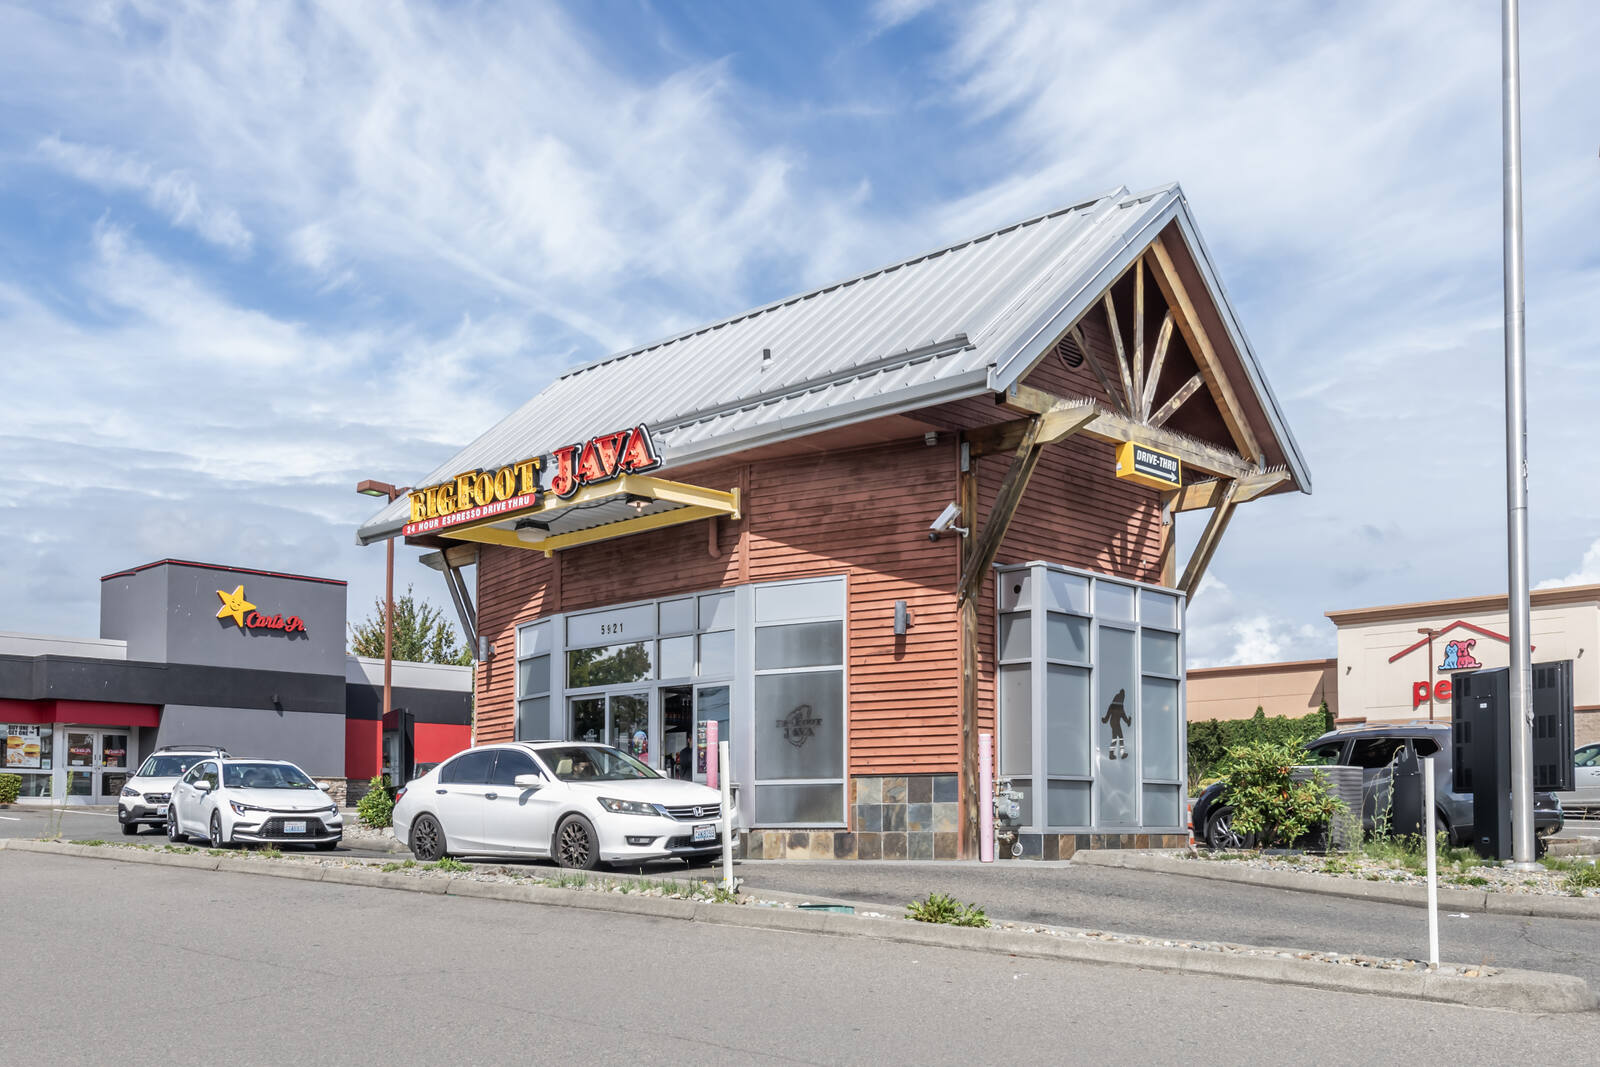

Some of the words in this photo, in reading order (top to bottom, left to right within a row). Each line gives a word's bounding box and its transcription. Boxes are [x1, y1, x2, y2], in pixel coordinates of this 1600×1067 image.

[408, 457, 541, 524] BIGFOOT
[552, 424, 660, 498] JAVA
[1136, 449, 1177, 472] DRIVE-THRU
[407, 525, 416, 534] 24
[418, 518, 439, 531] HOUR
[442, 509, 480, 525] ESPRESSO
[483, 502, 506, 516] DRIVE
[508, 496, 530, 509] THRU
